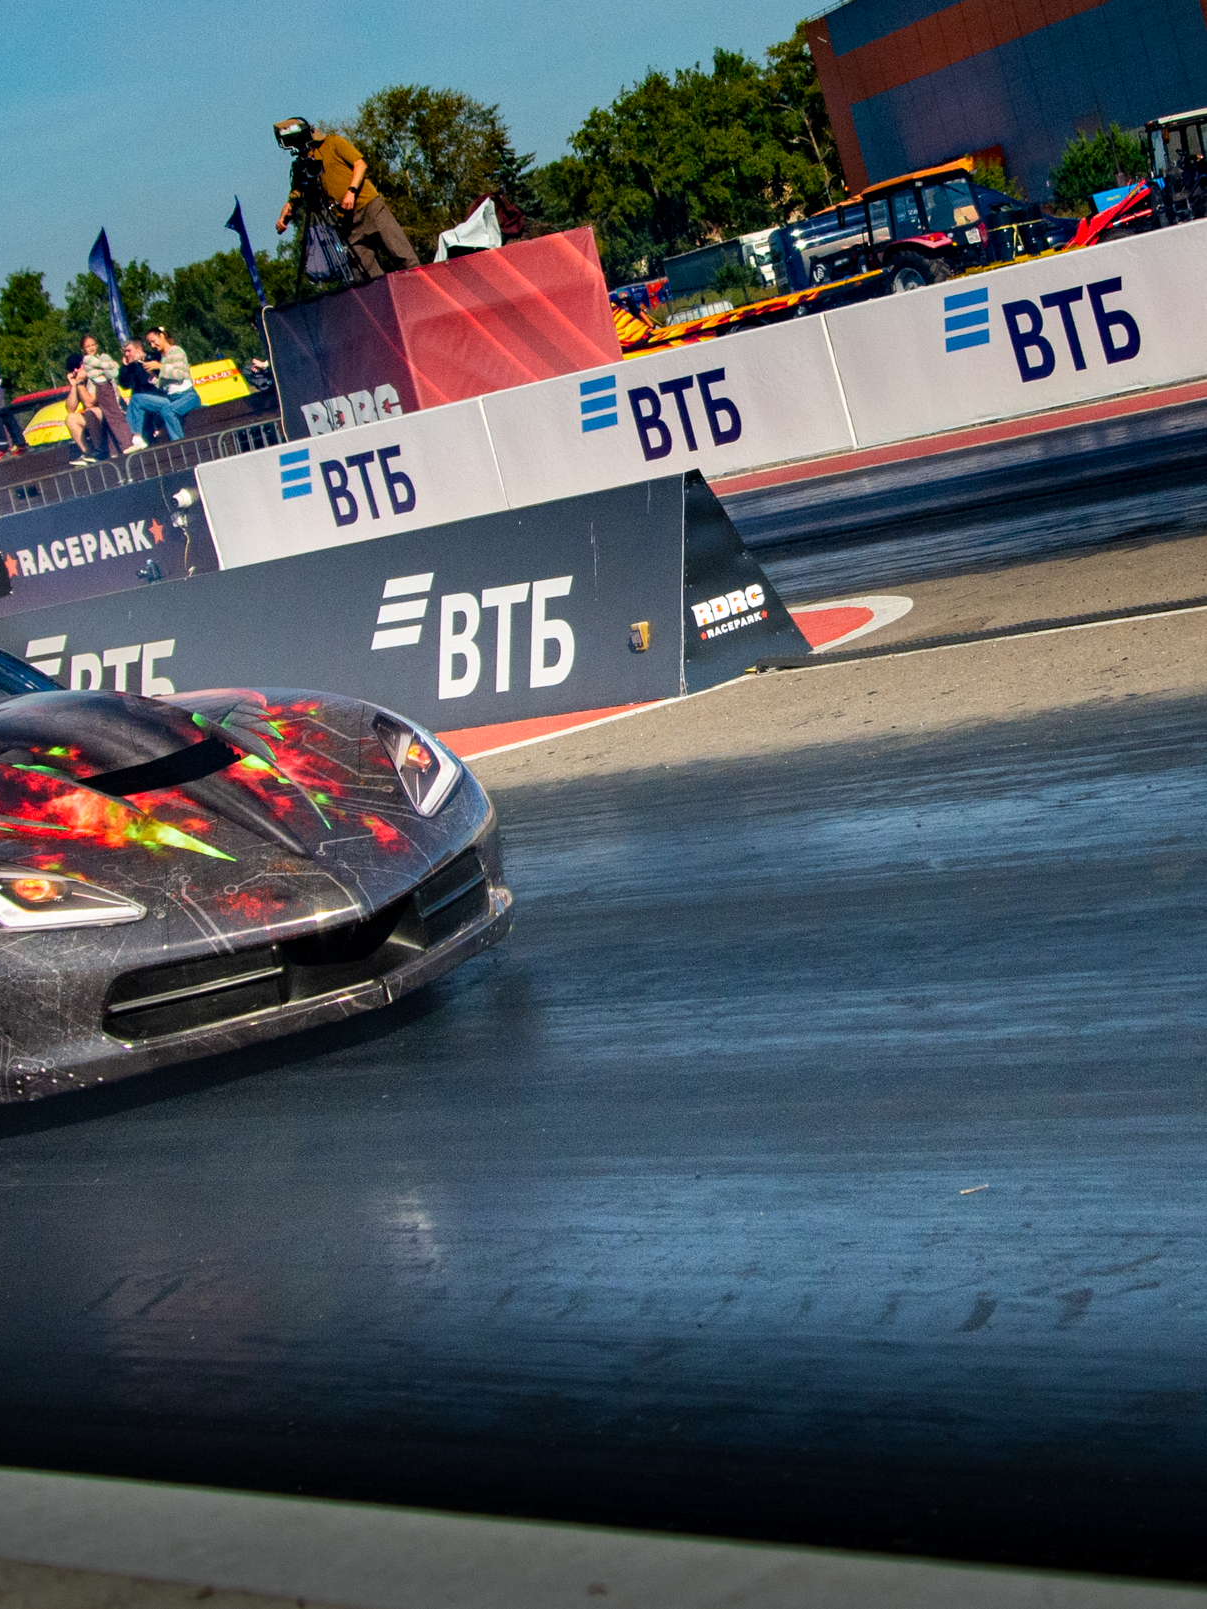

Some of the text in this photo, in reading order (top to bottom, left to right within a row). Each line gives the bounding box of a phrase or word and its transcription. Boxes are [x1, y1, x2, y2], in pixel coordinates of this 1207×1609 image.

[1001, 275, 1141, 383] ВТБ
[627, 367, 742, 461] ВТБ
[319, 444, 416, 527] ВТБ
[16, 520, 152, 577] RACEPARK
[438, 575, 575, 700] ВТБ
[691, 584, 765, 628] RDRC
[705, 611, 762, 639] RACEPARK
